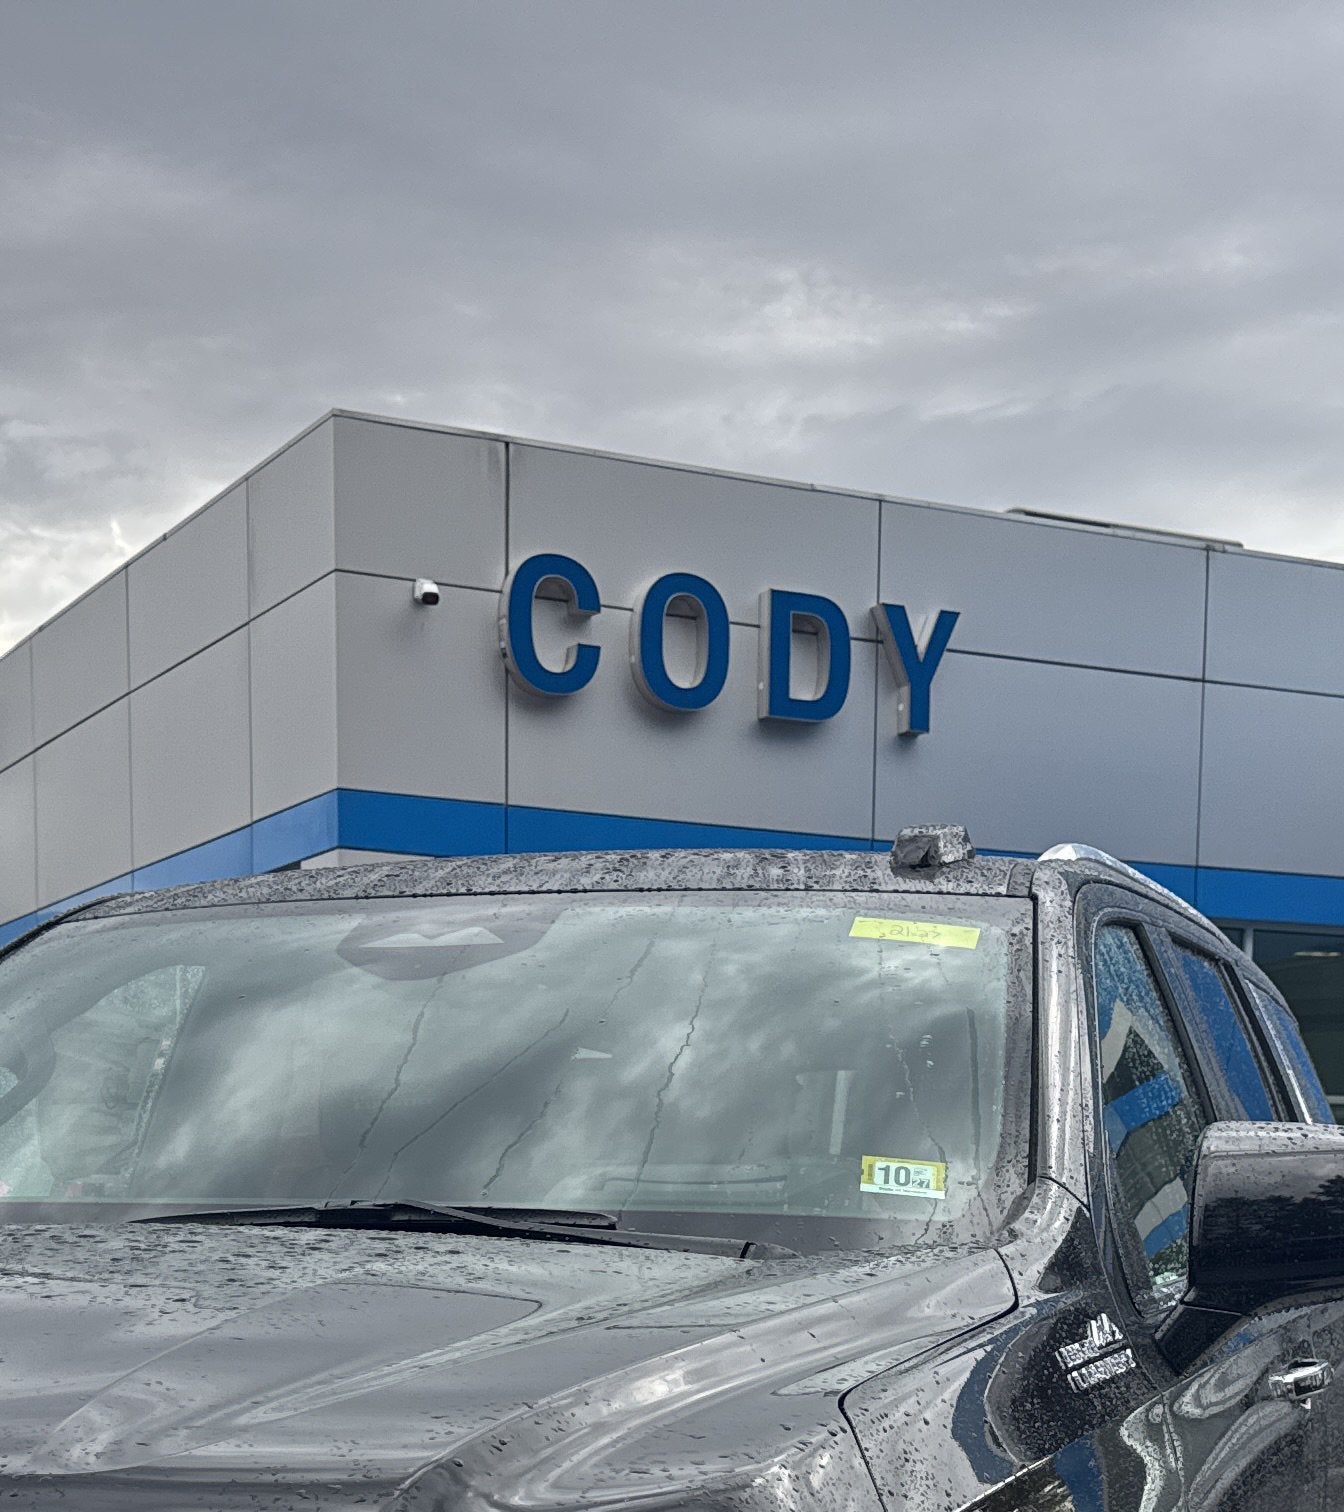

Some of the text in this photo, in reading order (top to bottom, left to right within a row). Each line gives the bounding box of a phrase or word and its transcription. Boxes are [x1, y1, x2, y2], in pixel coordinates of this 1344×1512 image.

[499, 553, 961, 737] CODY
[877, 1164, 911, 1187] 10
[912, 1178, 931, 1189] 27
